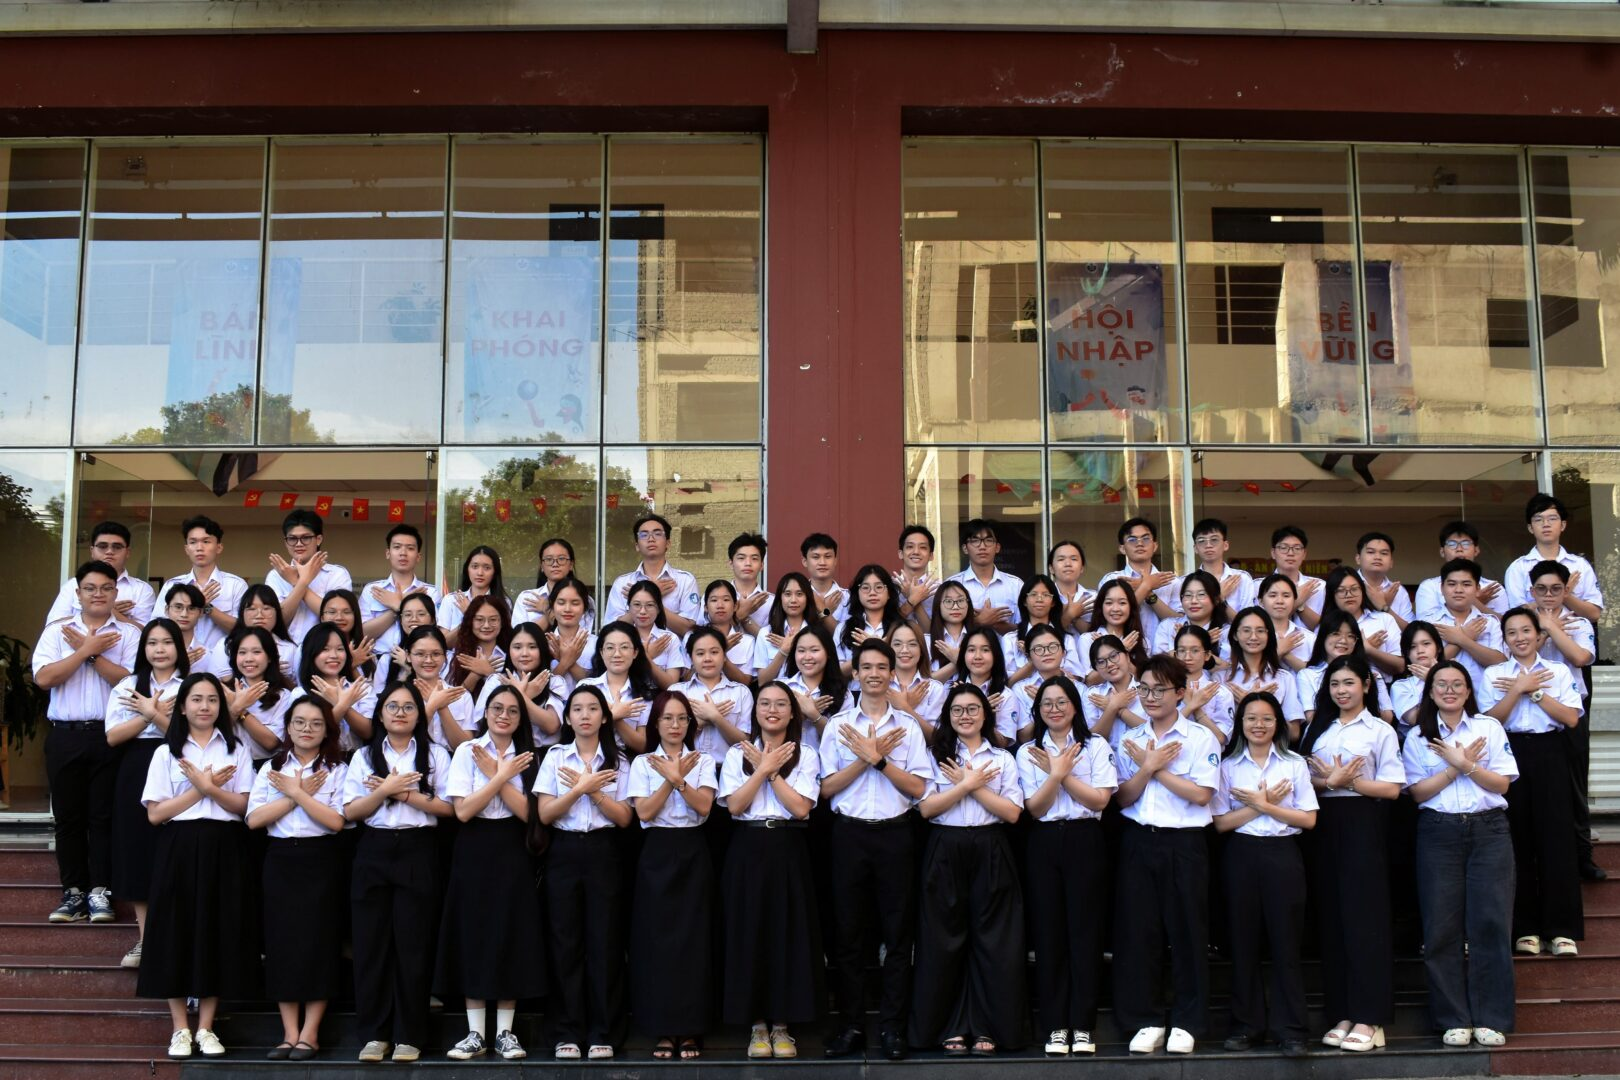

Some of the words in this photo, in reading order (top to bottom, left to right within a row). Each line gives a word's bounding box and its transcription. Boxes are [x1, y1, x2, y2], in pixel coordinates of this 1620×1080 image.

[491, 310, 566, 328] KHAI
[1071, 303, 1134, 335] HỘI
[471, 333, 584, 358] PHÓNG
[1056, 334, 1154, 367] NHẬP
